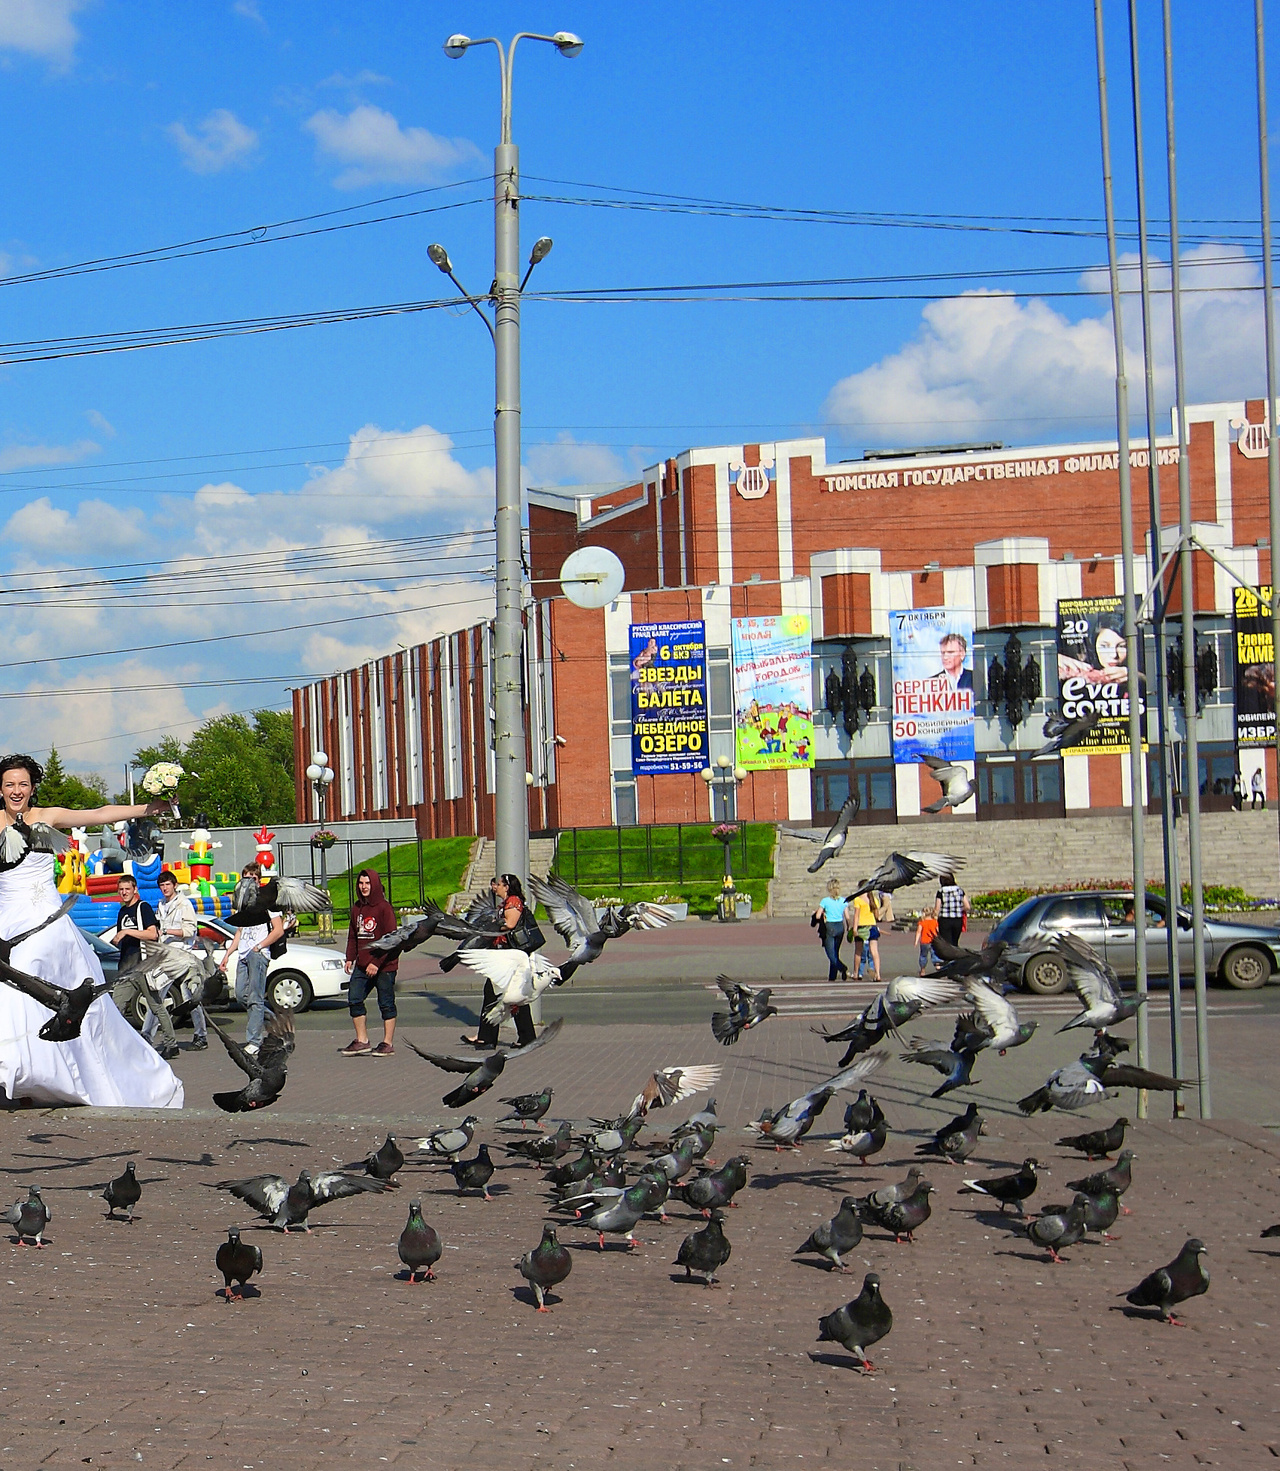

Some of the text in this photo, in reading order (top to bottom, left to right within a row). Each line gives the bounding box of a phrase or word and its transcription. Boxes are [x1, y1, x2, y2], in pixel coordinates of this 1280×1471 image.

[825, 471, 898, 493] ТОМСКАЯ
[903, 458, 1059, 487] ГОСУДАРСТВЕННАЯ
[632, 624, 657, 632] РУССКИЙ
[896, 612, 946, 630] 7 ОКТЯБРЯ
[1062, 620, 1089, 634] 20
[660, 642, 704, 661] 6 октября
[672, 650, 690, 660] БКЗ
[1238, 645, 1275, 665] КАМЕ
[638, 665, 702, 684] ЗВЕЗДЫ
[755, 665, 801, 682] ГОРОДОК
[894, 674, 948, 695] СЕРГЕЙ
[638, 689, 703, 708] БАЛЕТА
[895, 691, 970, 715] ПЕНКИН
[634, 720, 706, 736] ЛЕБЕДИНОЕ
[895, 719, 969, 738] 50 ЮБИЛЕЙНЫЙ
[917, 727, 952, 735] КОНЦЕРТ
[640, 733, 702, 753] ОЗЕРО
[670, 761, 703, 771] 51-59-56
